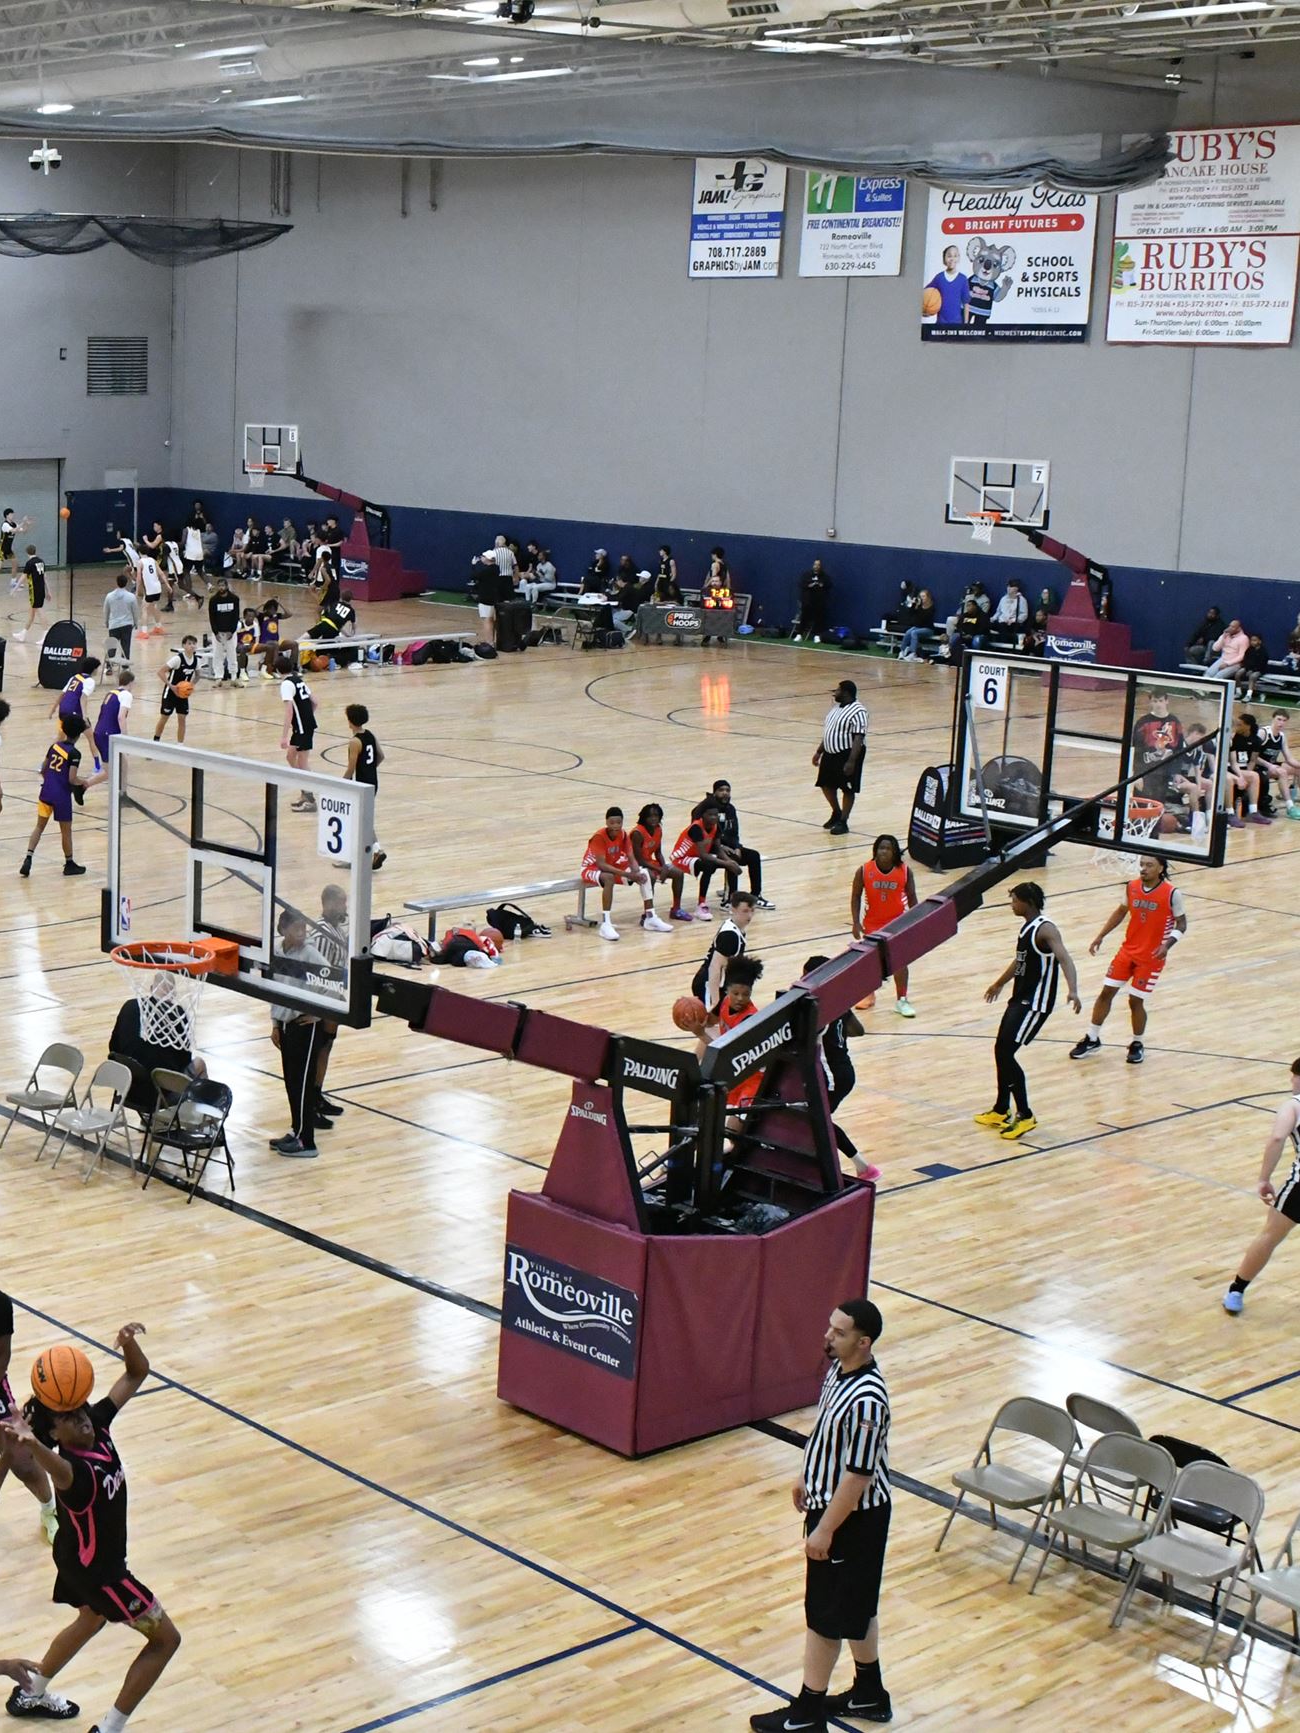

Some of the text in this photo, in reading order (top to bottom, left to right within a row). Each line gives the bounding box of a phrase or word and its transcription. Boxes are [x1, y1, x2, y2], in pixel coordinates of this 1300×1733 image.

[1174, 130, 1277, 163] UBY'S
[1164, 163, 1269, 178] ANCAKE HOUSE
[858, 177, 901, 192] Express
[698, 190, 731, 204] JAM!
[872, 193, 893, 203] Suites
[942, 190, 1024, 216] Healthy
[807, 219, 820, 230] FREE
[821, 218, 860, 229] CONTINENTAL
[964, 218, 1058, 231] BRIGHT FUTURES
[831, 231, 872, 240] Romeoville
[708, 245, 767, 258] 708.717.2889
[1140, 240, 1267, 270] RUBY'S
[1026, 256, 1075, 268] SCHOOL
[1021, 271, 1079, 283] & SPORTS
[1138, 270, 1265, 292] BURRITOS
[1016, 286, 1081, 298] PHYSICALS
[1155, 309, 1244, 318] www.rubysburritos.com
[1035, 470, 1042, 482] 7
[148, 564, 154, 574] 6
[711, 588, 730, 598] 7:27
[335, 602, 350, 619] 40
[674, 612, 694, 620] PREP
[673, 619, 699, 627] HOOPS
[1046, 634, 1097, 650] Romeoville
[979, 664, 1006, 677] COURT
[983, 677, 998, 705] 6
[365, 744, 374, 765] 3
[49, 753, 64, 773] 22
[321, 797, 351, 816] COURT
[326, 816, 343, 854] 3
[306, 971, 345, 995] SPALDING
[731, 1021, 794, 1077] SPALDING
[623, 1056, 680, 1090] PALDING
[570, 1104, 607, 1127] SPALDING
[530, 1261, 573, 1283] Village of
[507, 1251, 634, 1326] Romeoville
[579, 1321, 611, 1332] Community
[514, 1316, 621, 1368] Athletic & Event Center
